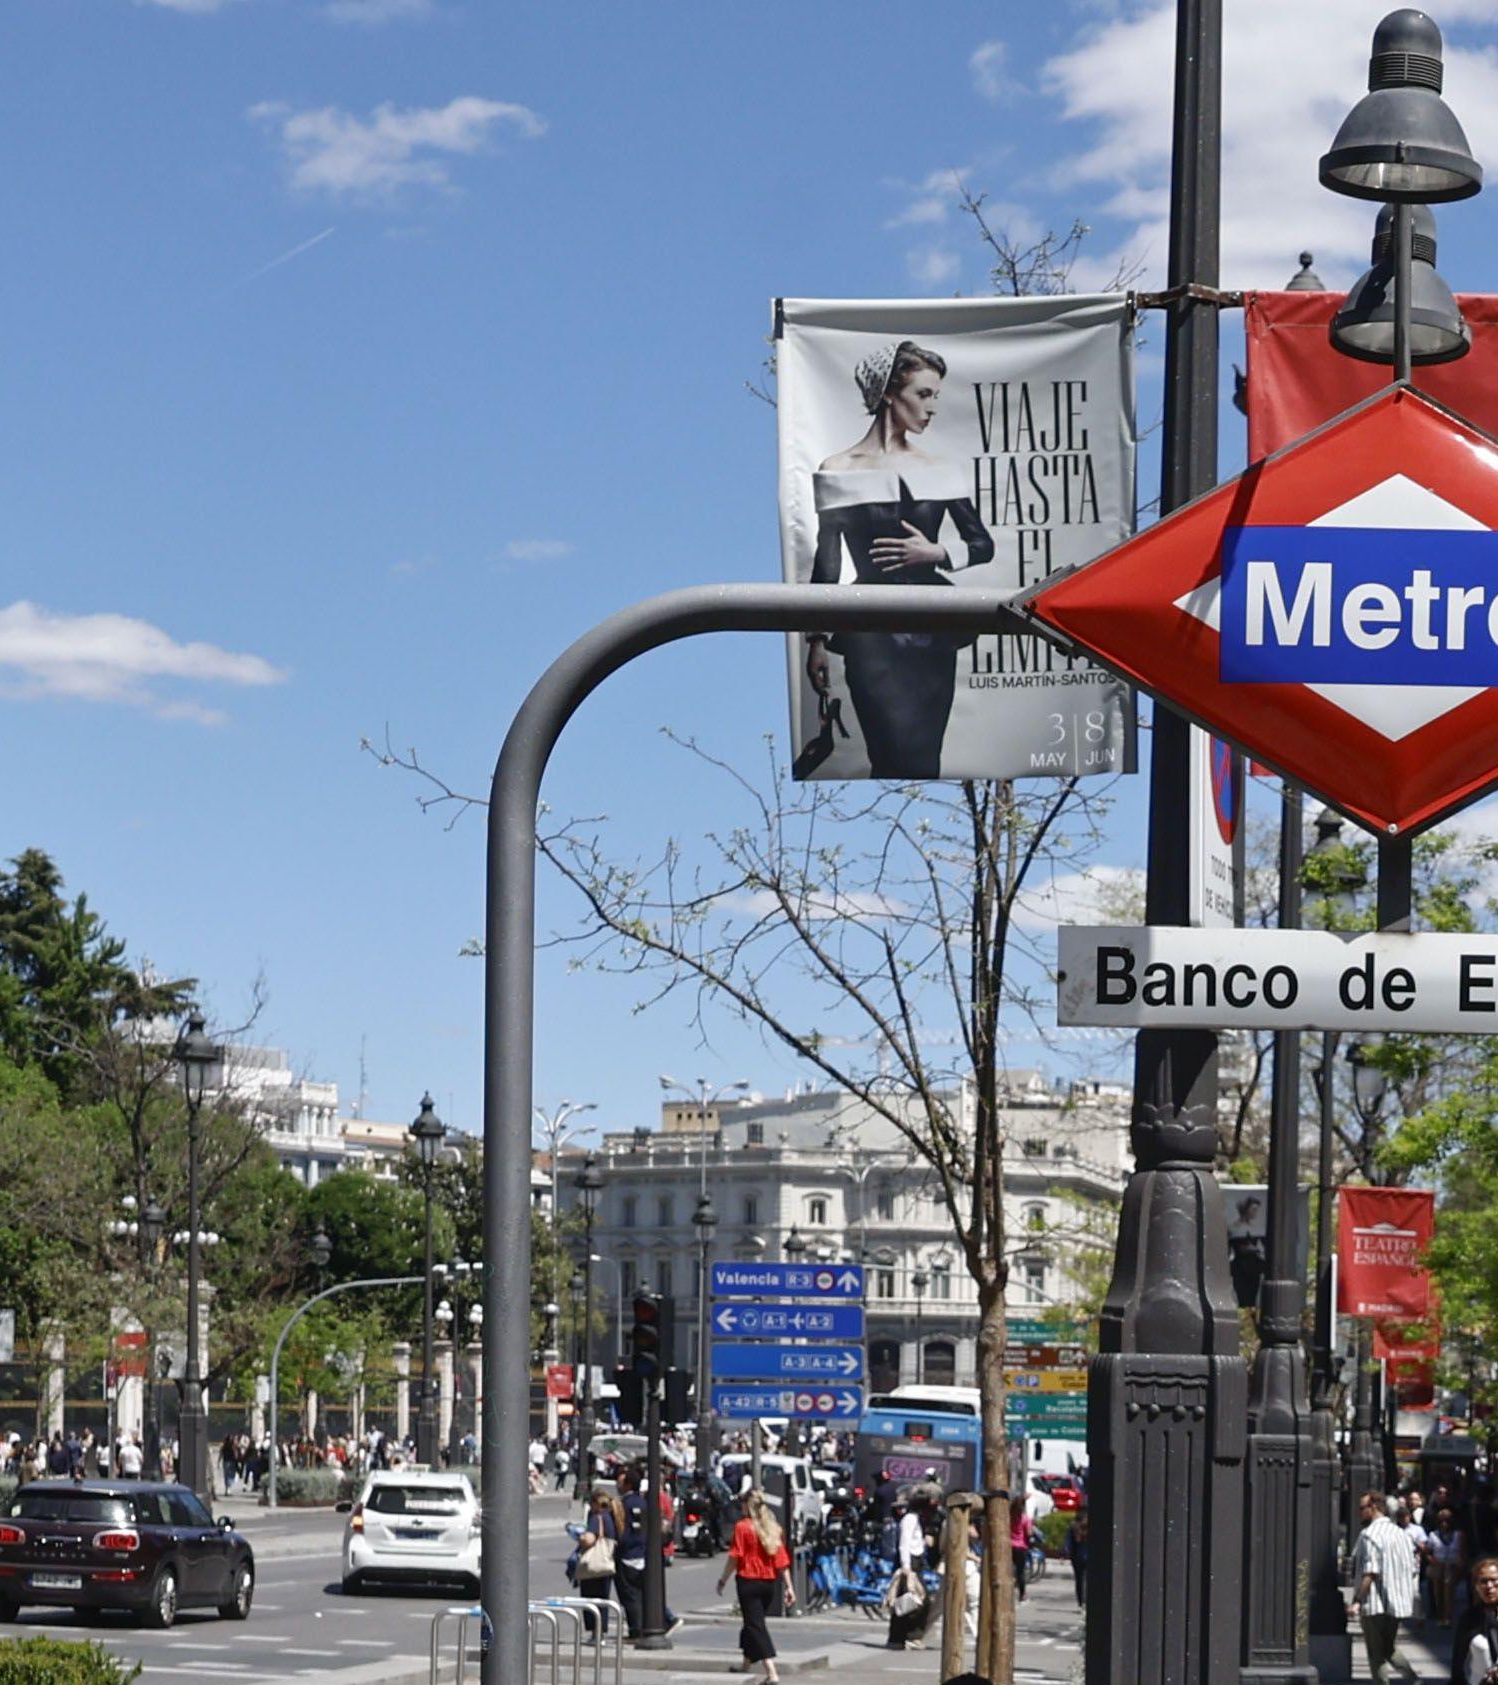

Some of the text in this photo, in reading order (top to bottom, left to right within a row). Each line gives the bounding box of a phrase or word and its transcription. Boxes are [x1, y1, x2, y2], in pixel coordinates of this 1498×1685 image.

[972, 380, 1089, 454] VIAJE
[972, 454, 1102, 527] HASTA
[968, 675, 999, 689] LUIS
[1047, 710, 1106, 746] 3 8
[1030, 748, 1116, 769] MAY JUN
[1095, 946, 1299, 1009] Banco
[1338, 952, 1417, 1012] de
[716, 1271, 810, 1286] Valencia R-3
[809, 1315, 831, 1327] A-2
[784, 1356, 834, 1368] A-3 A-4
